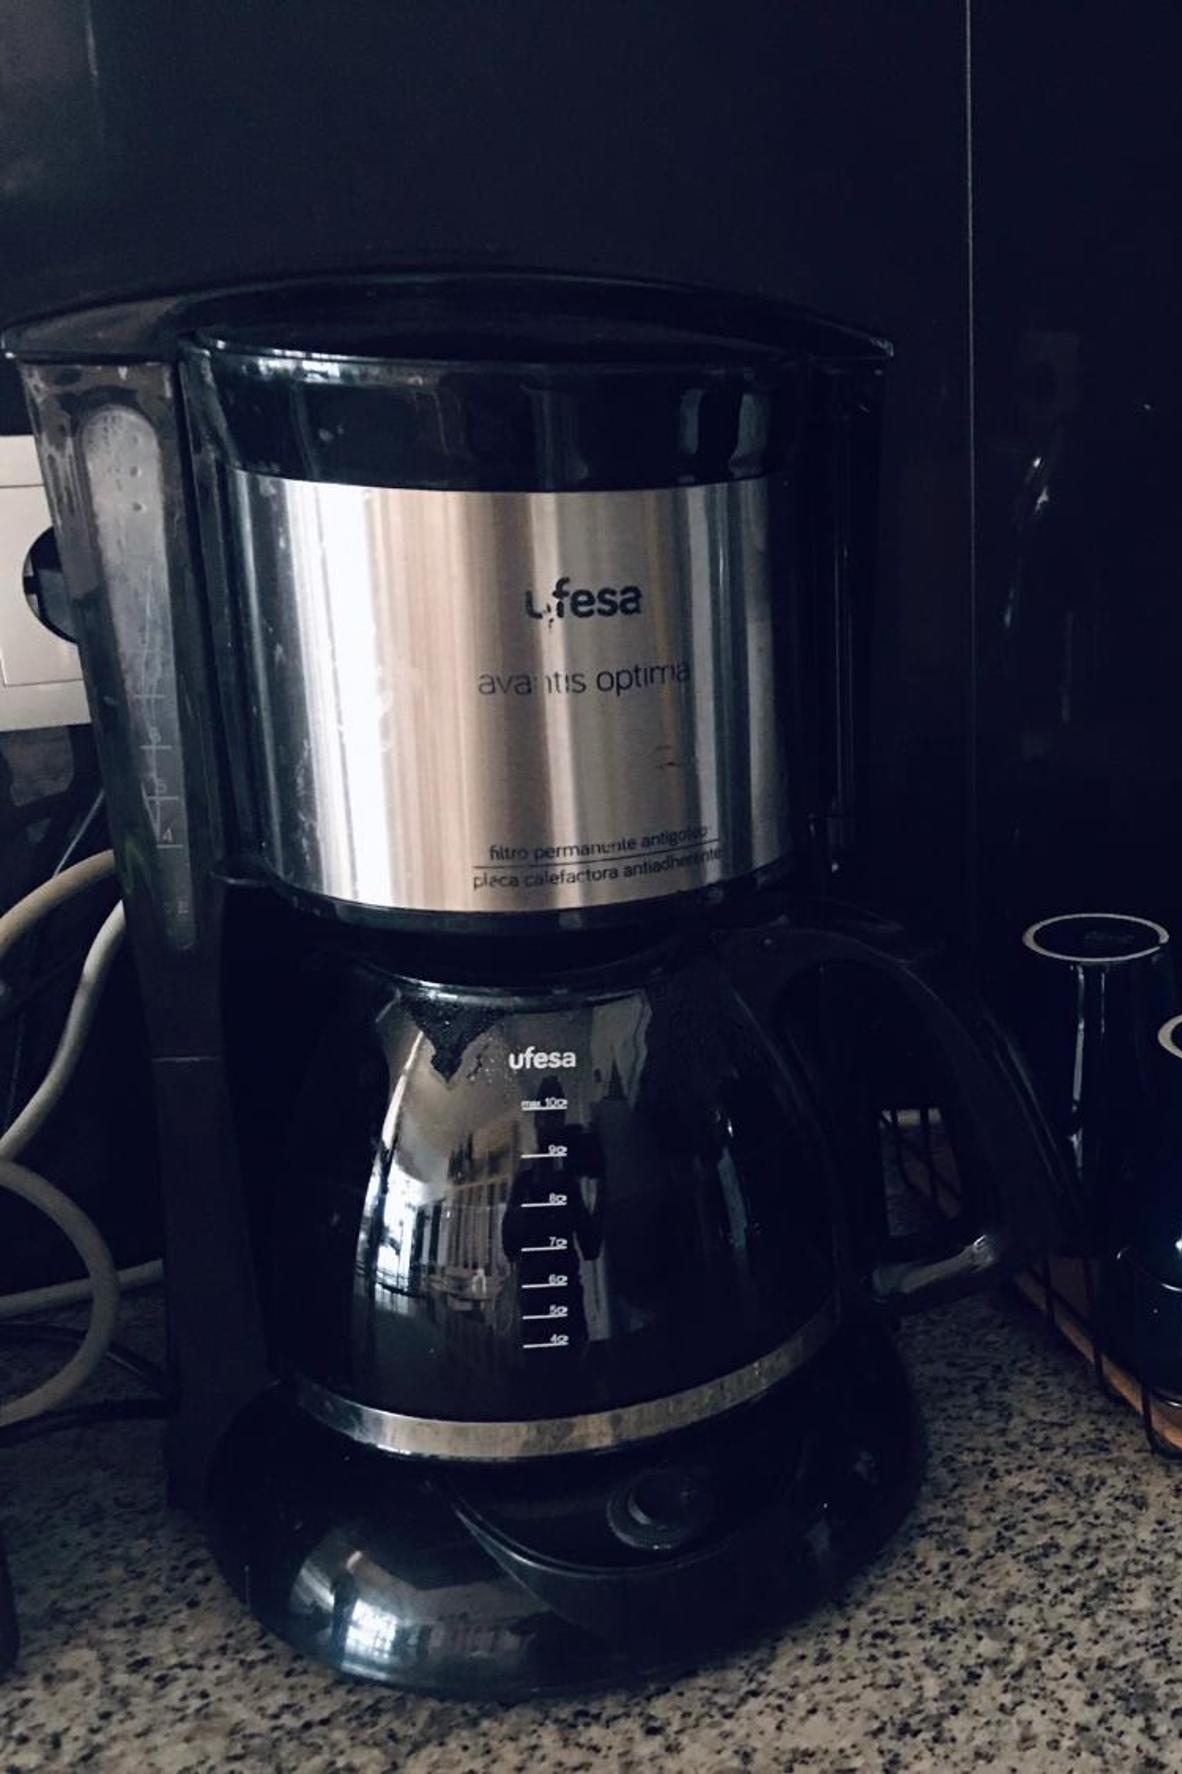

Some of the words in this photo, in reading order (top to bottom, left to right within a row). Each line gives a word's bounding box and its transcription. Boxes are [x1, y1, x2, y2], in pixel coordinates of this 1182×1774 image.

[525, 577, 643, 619] ufesa
[478, 670, 587, 696] avantis
[596, 661, 691, 698] optima
[489, 844, 527, 862] filtro
[534, 837, 638, 862] permanente
[641, 827, 708, 849] antigoo
[473, 867, 520, 890] placa
[524, 861, 619, 888] calefactora
[623, 848, 721, 879] antiadhente
[508, 1046, 577, 1070] ufesa
